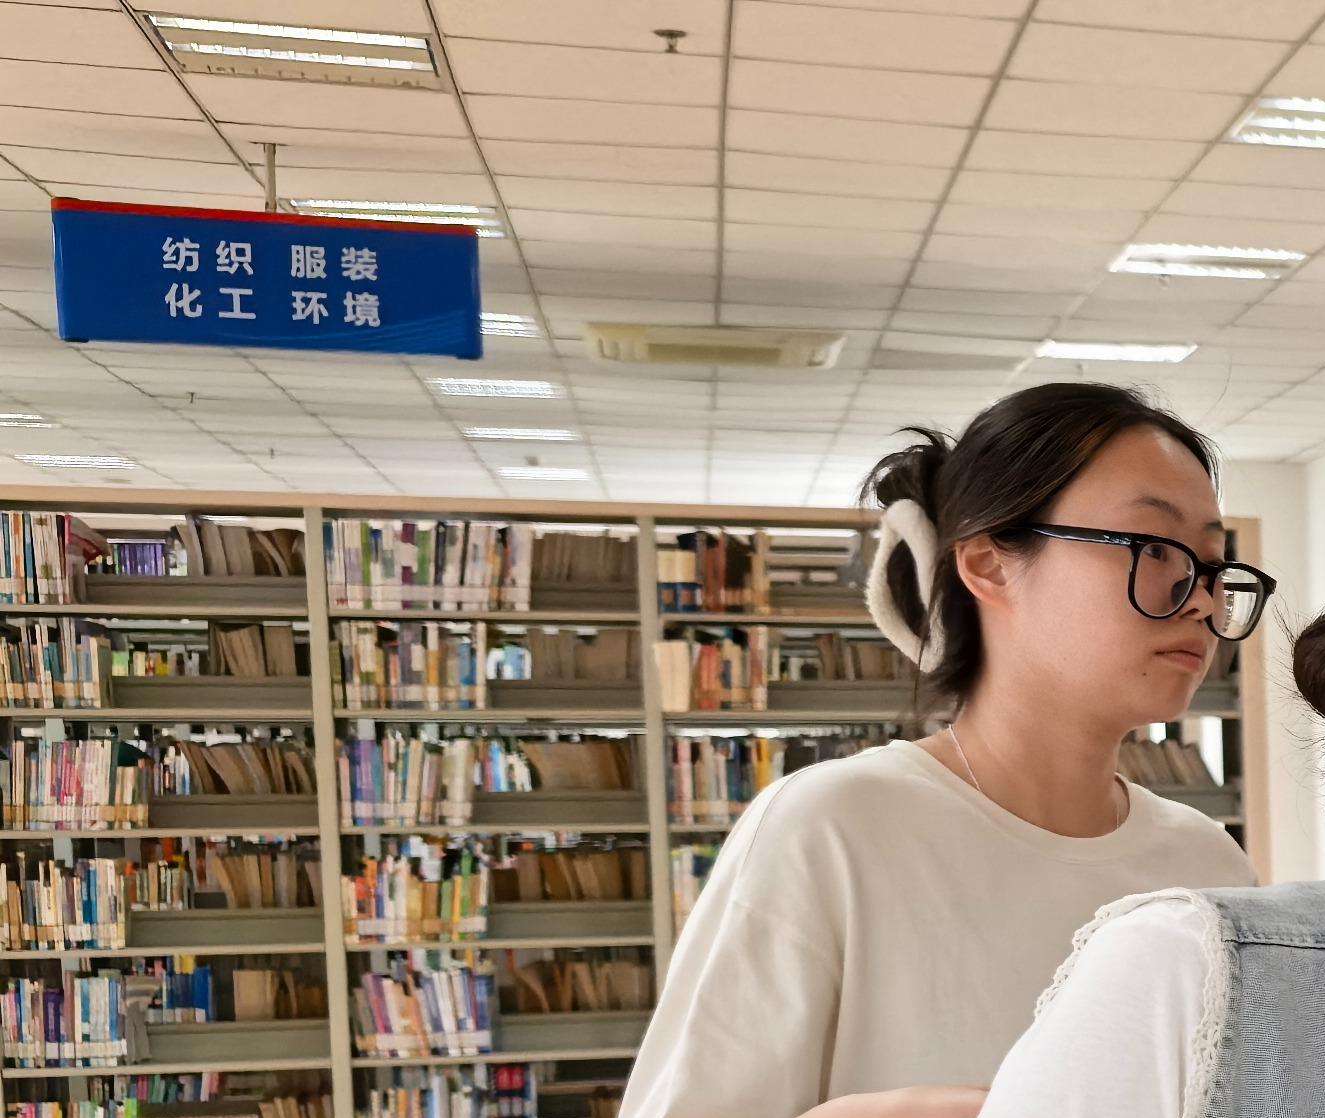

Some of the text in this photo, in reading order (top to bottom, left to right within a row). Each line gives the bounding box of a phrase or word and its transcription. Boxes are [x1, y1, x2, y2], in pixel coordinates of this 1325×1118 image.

[161, 236, 379, 281] 纺织 服装
[165, 282, 382, 329] 化工 环境
